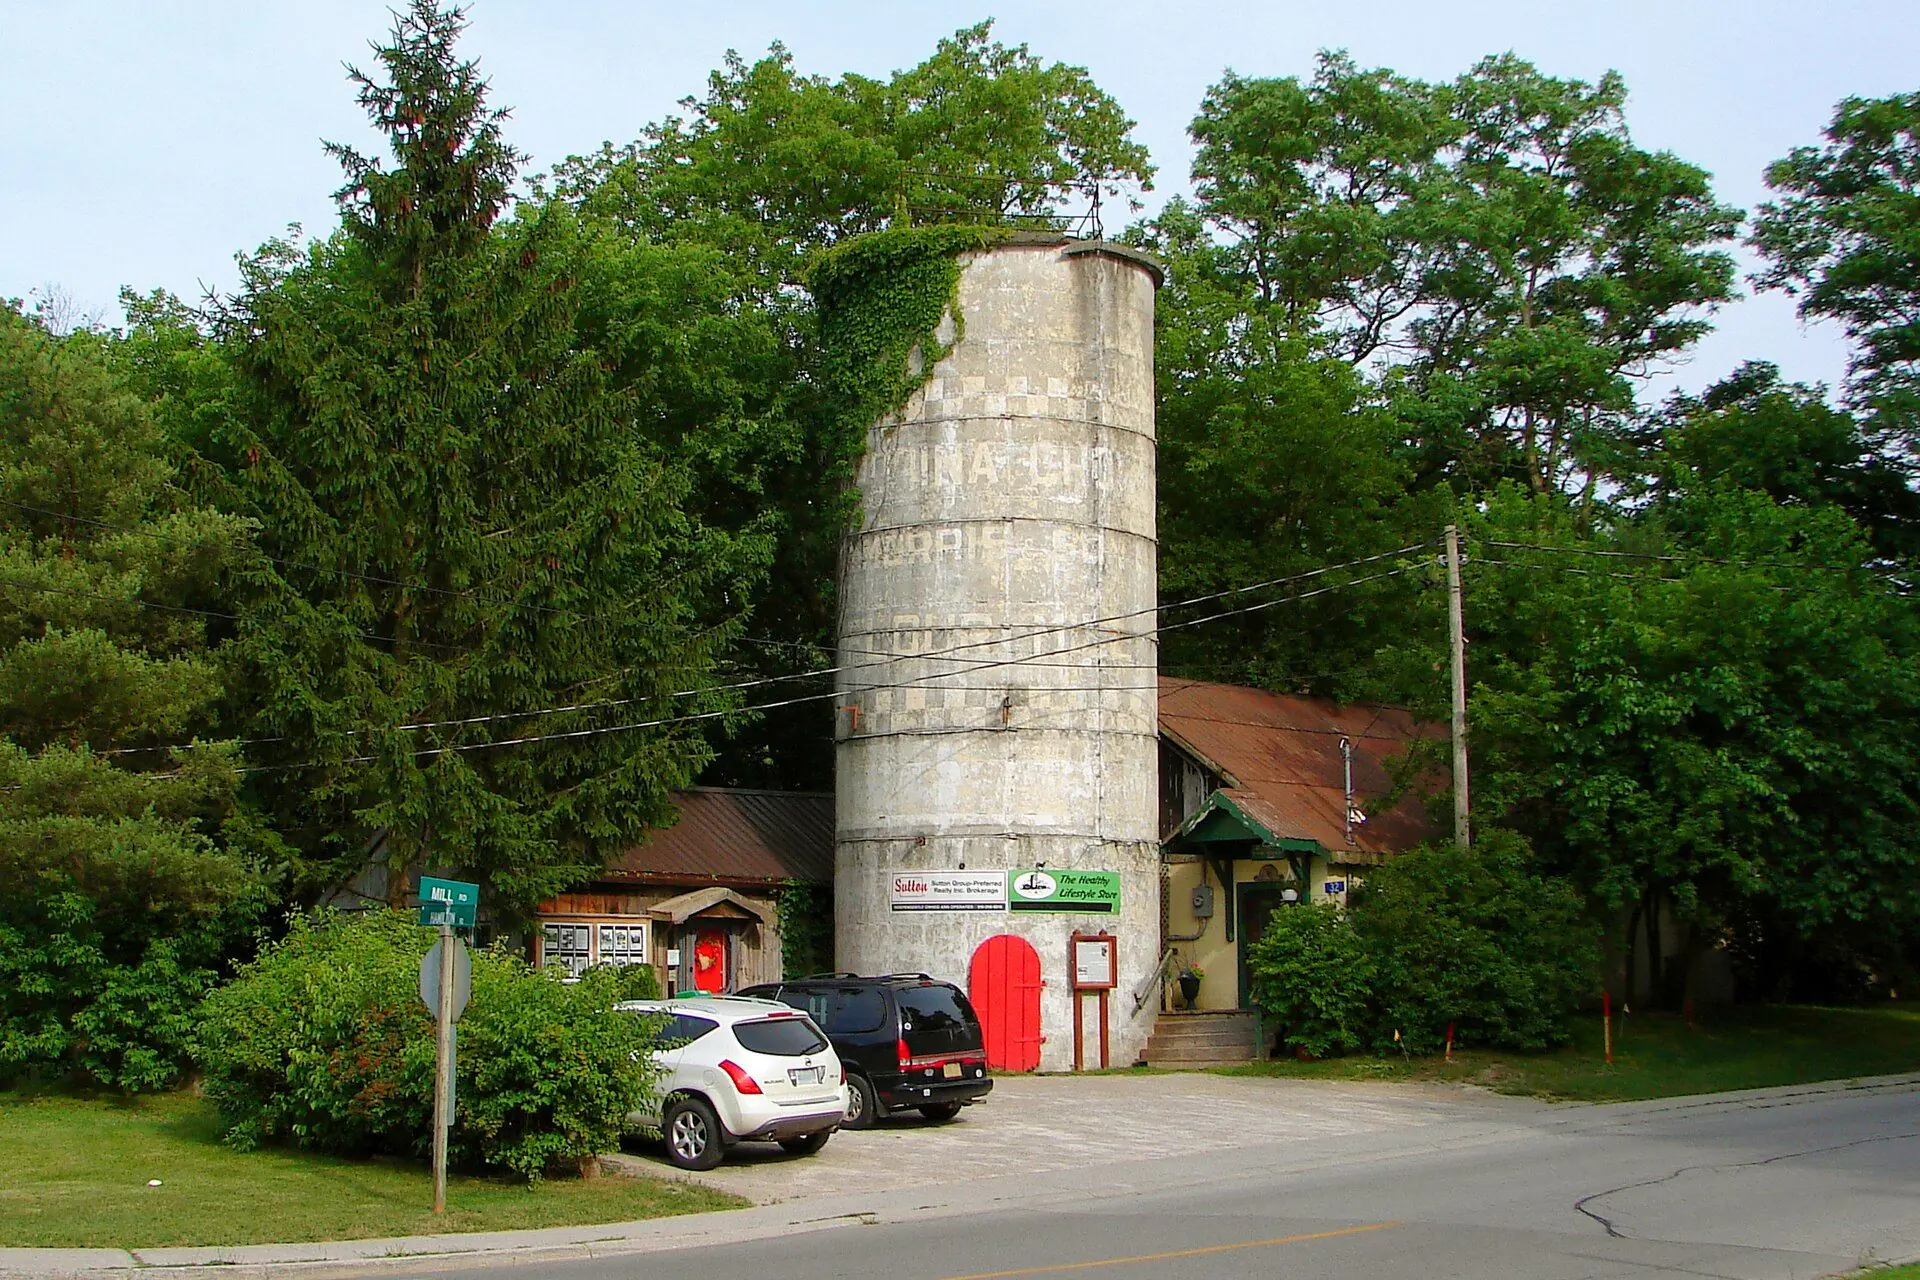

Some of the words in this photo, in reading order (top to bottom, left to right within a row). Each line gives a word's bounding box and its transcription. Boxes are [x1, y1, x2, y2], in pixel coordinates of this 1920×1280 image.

[895, 878, 928, 893] Sutton
[1060, 874, 1076, 884] The
[1079, 875, 1111, 887] Healthy
[431, 886, 453, 902] MILL
[458, 893, 468, 901] RD
[1060, 889, 1096, 900] Lifestyle
[1097, 889, 1118, 899] Store
[430, 911, 456, 924] HAMILON
